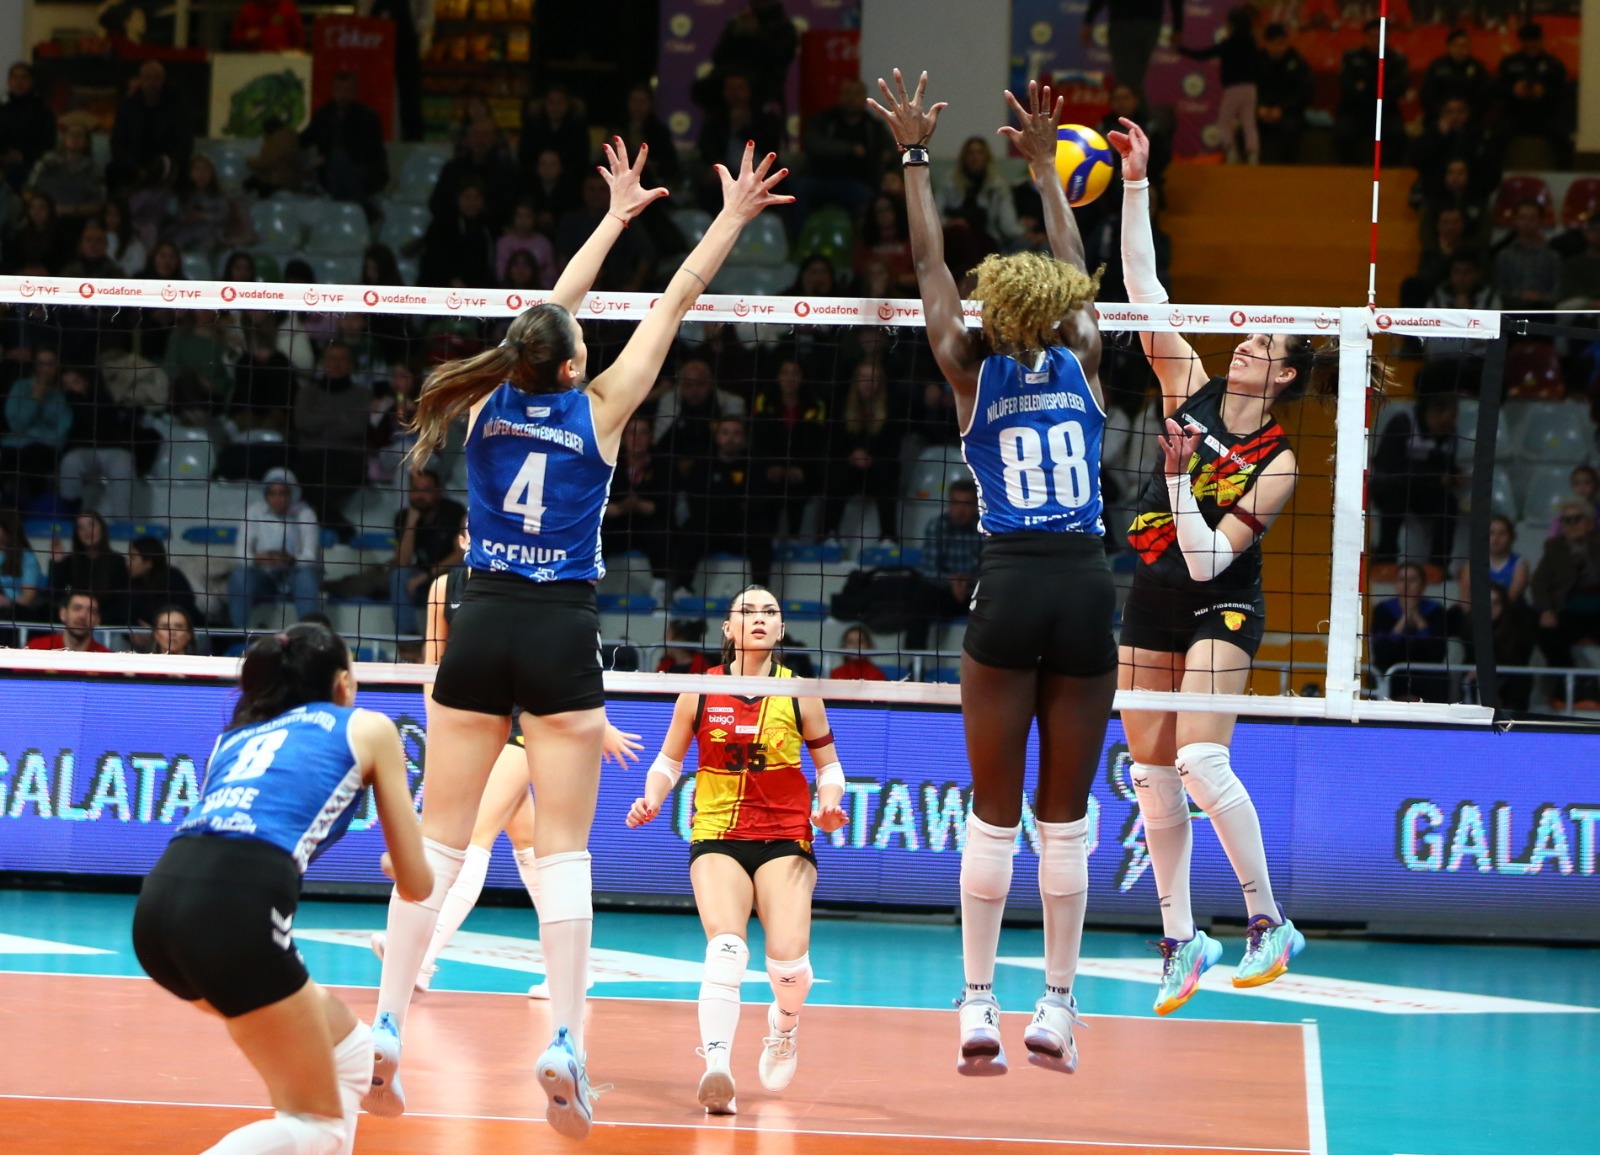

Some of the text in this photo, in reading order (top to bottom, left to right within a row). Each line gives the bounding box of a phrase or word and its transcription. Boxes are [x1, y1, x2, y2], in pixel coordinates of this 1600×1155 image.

[98, 288, 142, 296] vodafone
[180, 290, 202, 299] TVF
[239, 290, 284, 300] vodafone
[322, 294, 344, 303] TVF
[381, 296, 427, 304] vodafone
[464, 298, 487, 307] TVF
[609, 302, 630, 311] TVF
[752, 305, 775, 314] TVF
[813, 306, 859, 315] vodafone
[896, 308, 919, 318] TVF
[1103, 312, 1149, 321] vodafone
[1187, 315, 1210, 325] TVF
[1249, 316, 1295, 324] vodafone
[1395, 318, 1441, 327] vodafone
[1066, 392, 1087, 414] EKER
[564, 430, 584, 455] EKER
[999, 420, 1091, 509] 88
[503, 452, 547, 535] 4
[222, 728, 289, 783] 8
[725, 743, 768, 772] 35
[1400, 801, 1600, 877] GALAT
